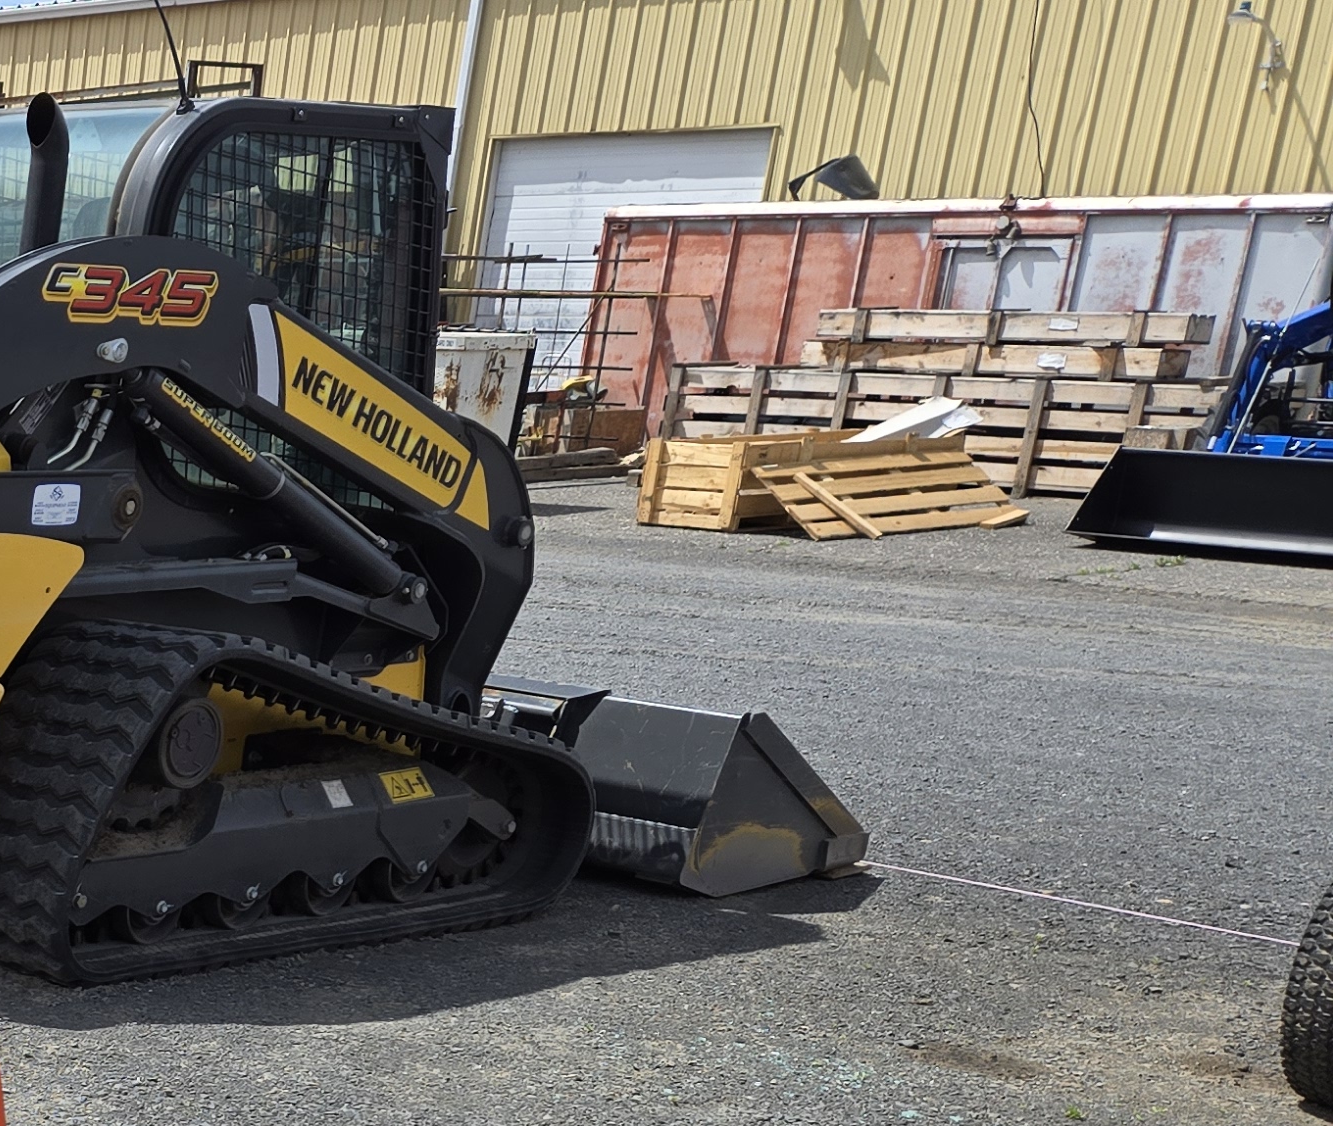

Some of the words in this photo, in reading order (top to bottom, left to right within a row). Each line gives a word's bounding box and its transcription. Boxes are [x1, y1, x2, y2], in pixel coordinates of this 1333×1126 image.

[44, 263, 219, 323] C345
[162, 377, 214, 428] SUPER
[211, 418, 257, 462] BOOM
[291, 355, 357, 420] NEW
[351, 395, 462, 490] HOLLAND
